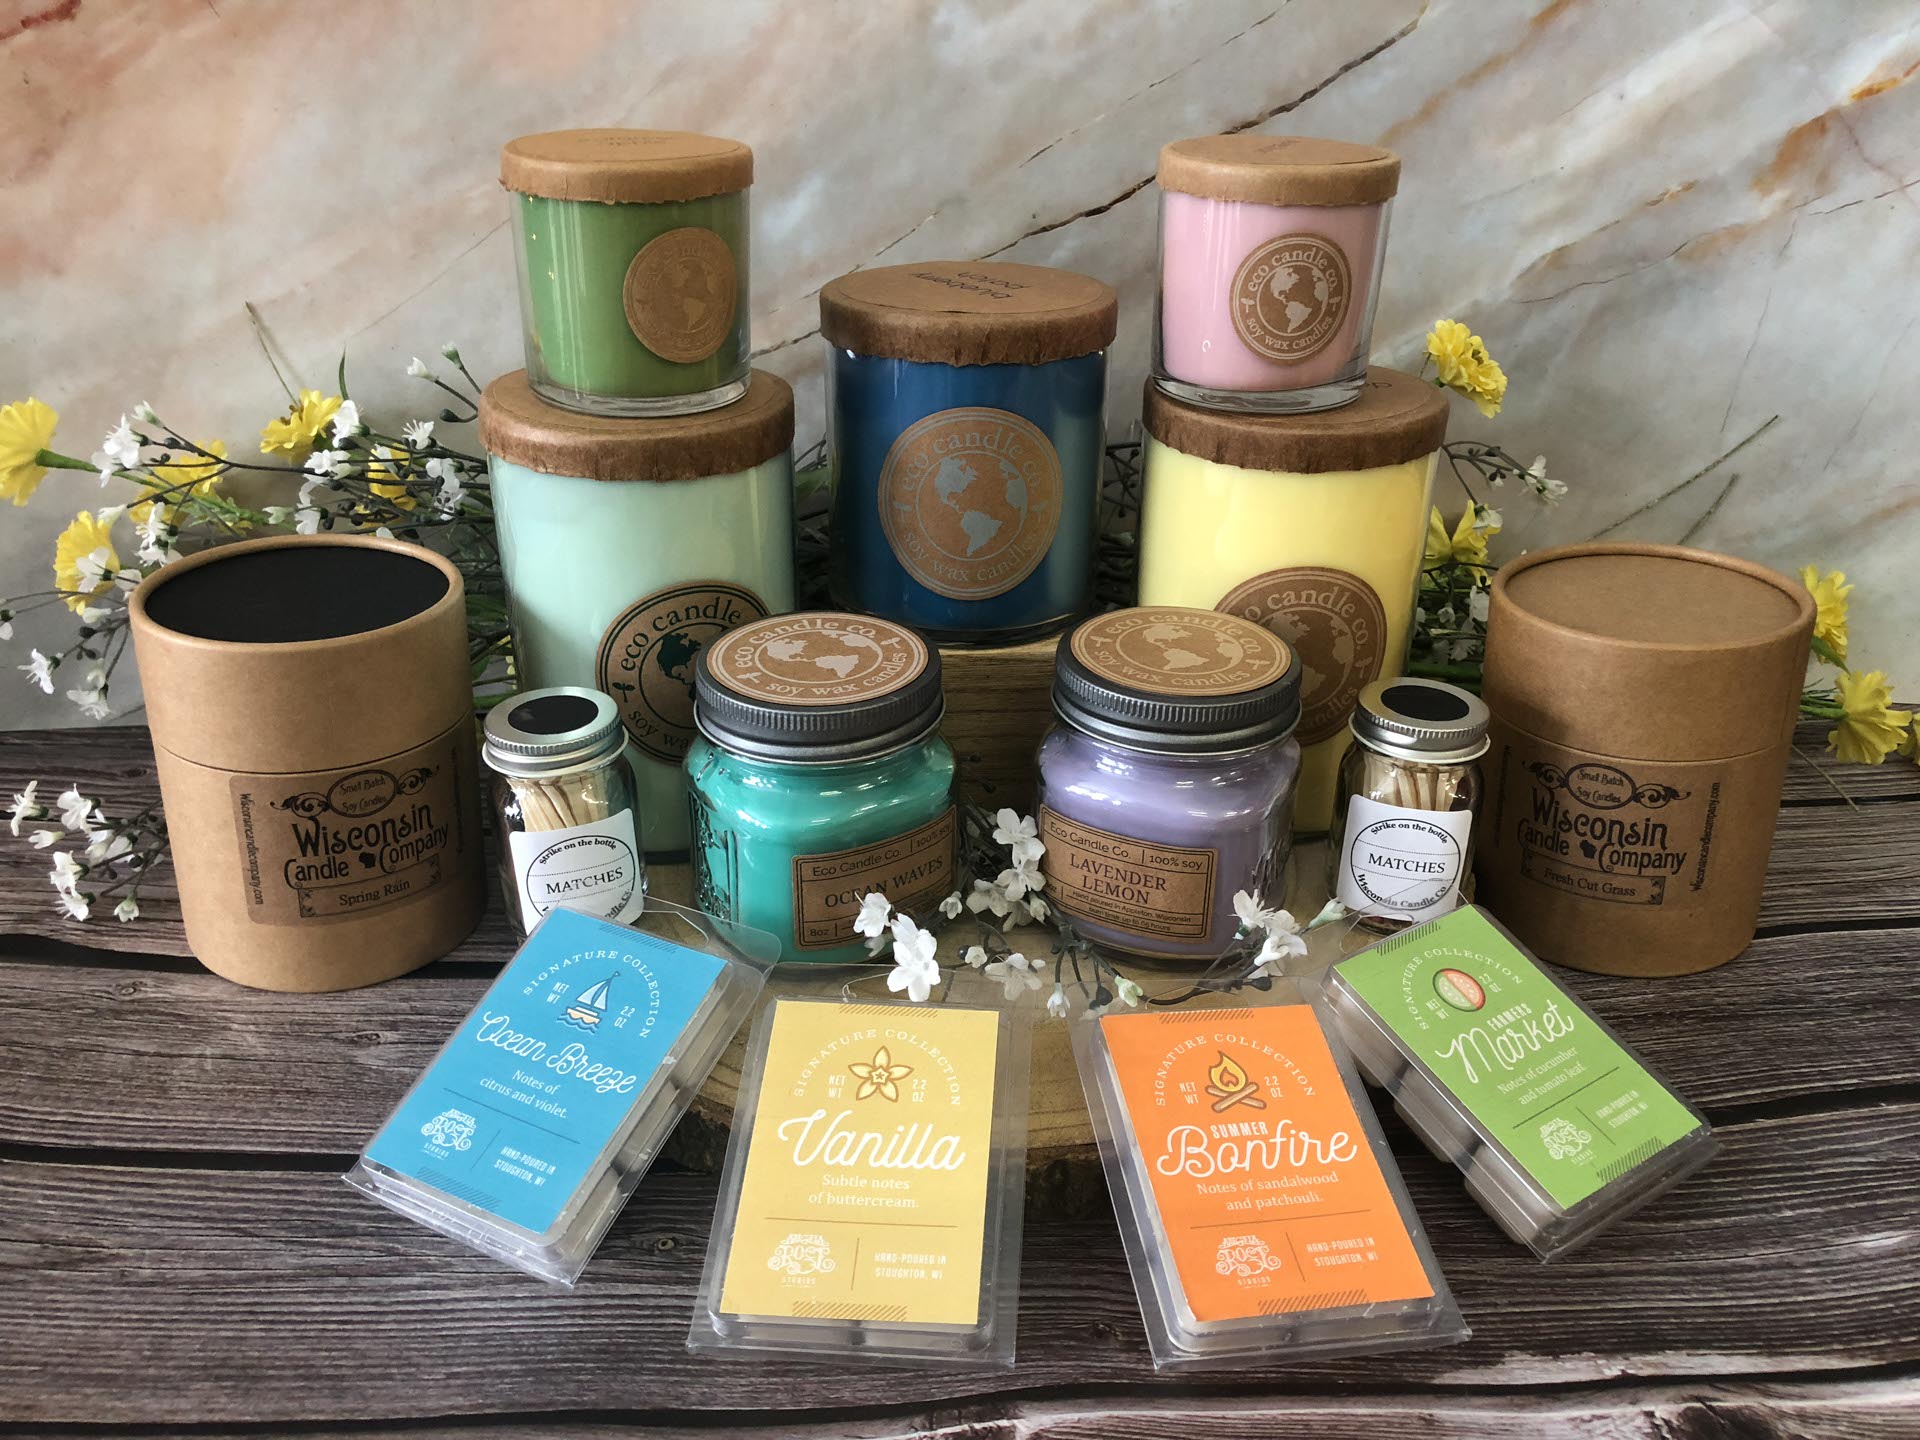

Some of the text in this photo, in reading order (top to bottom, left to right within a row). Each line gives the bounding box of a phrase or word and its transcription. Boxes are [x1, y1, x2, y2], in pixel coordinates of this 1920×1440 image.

[1248, 247, 1337, 292] eco candle co.
[1247, 317, 1332, 349] soy wax candles
[902, 429, 1023, 491] eco candle
[904, 533, 929, 561] soy
[933, 559, 970, 582] wax
[1106, 618, 1143, 634] eco
[1150, 614, 1243, 636] candle
[1267, 587, 1356, 618] candle
[1352, 618, 1368, 649] co.
[621, 597, 741, 671] eco candle
[735, 646, 755, 668] eco
[750, 619, 839, 644] candle
[766, 652, 908, 696] soy wax candles
[1095, 651, 1251, 686] soy wax candles
[628, 710, 689, 749] soy wa
[340, 776, 386, 795] Small Batch
[1578, 770, 1624, 786] Small Batch
[342, 802, 358, 813] Soy
[1576, 787, 1621, 803] Soy Candles
[292, 804, 434, 857] Wisconsin
[1532, 787, 1667, 850] Wisconsin
[1050, 822, 1203, 870] Eco Candle Co. 100% soy
[1371, 823, 1396, 834] Strike
[1412, 823, 1426, 831] the
[1427, 827, 1448, 844] bottle
[1517, 818, 1687, 875] Candle Company
[240, 793, 263, 905] Wisconsincandlecompany.com
[284, 823, 449, 889] Candle Company
[539, 847, 563, 865] Strike
[594, 839, 617, 850] bottle
[813, 866, 836, 876] Eco
[840, 855, 882, 872] Candle
[885, 850, 901, 860] Co.
[916, 833, 938, 848] 100%
[1368, 853, 1445, 873] MATCHES
[546, 867, 623, 895] MATCHES
[892, 856, 943, 886] WAVES
[1070, 853, 1167, 892] LAVENDER
[1544, 868, 1636, 897] Fresh Cut Grass
[339, 880, 410, 907] Spring Rain
[1082, 875, 1151, 905] LEMON
[1400, 897, 1434, 907] Candle
[810, 927, 830, 936] 8oz
[523, 950, 660, 1039] SIGNATURE COLLECTION
[547, 993, 561, 1004] WT
[553, 981, 570, 994] NET
[1402, 948, 1523, 1030] SIGNATURE COLLECTION
[620, 1005, 635, 1018] 2.2
[1426, 998, 1441, 1010] NET
[1436, 1009, 1449, 1020] WT
[1487, 1003, 1532, 1031] FARMERS
[614, 1017, 628, 1028] OZ
[476, 1011, 637, 1094] Ocean Breeze
[1435, 999, 1575, 1083] Market
[794, 1029, 961, 1105] SIGNATURE COLLECTION
[829, 1075, 847, 1085] NET
[1155, 1033, 1316, 1106] SIGNATURE COLLECTION
[1264, 1075, 1280, 1086] 2.2
[1497, 1047, 1578, 1094] Notes of cucumber
[512, 1070, 561, 1095] Notes of
[828, 1088, 842, 1099] WT
[912, 1079, 927, 1090] 2.2
[1179, 1082, 1198, 1093] NET
[1271, 1088, 1283, 1098] OZ
[1518, 1074, 1567, 1104] and tomato
[480, 1078, 567, 1119] citrus and violet.
[912, 1092, 925, 1103] OZ
[1185, 1094, 1200, 1105] WT
[777, 1108, 967, 1171] Vanilla
[1210, 1121, 1269, 1139] SUMMER
[500, 1146, 557, 1175] HAND-POURED IN
[1157, 1119, 1358, 1178] Bonfire
[493, 1159, 546, 1187] STOUGHTON, WI
[822, 1174, 911, 1190] Subtle notes
[1196, 1171, 1339, 1195] Notes of sandalwood
[808, 1193, 919, 1209] of buttercream.
[1226, 1191, 1324, 1211] and patchouli.
[937, 1253, 947, 1265] IN
[1306, 1237, 1375, 1253] HAND-POURED IN
[1367, 1253, 1378, 1261] WI
[931, 1269, 943, 1281] WI
